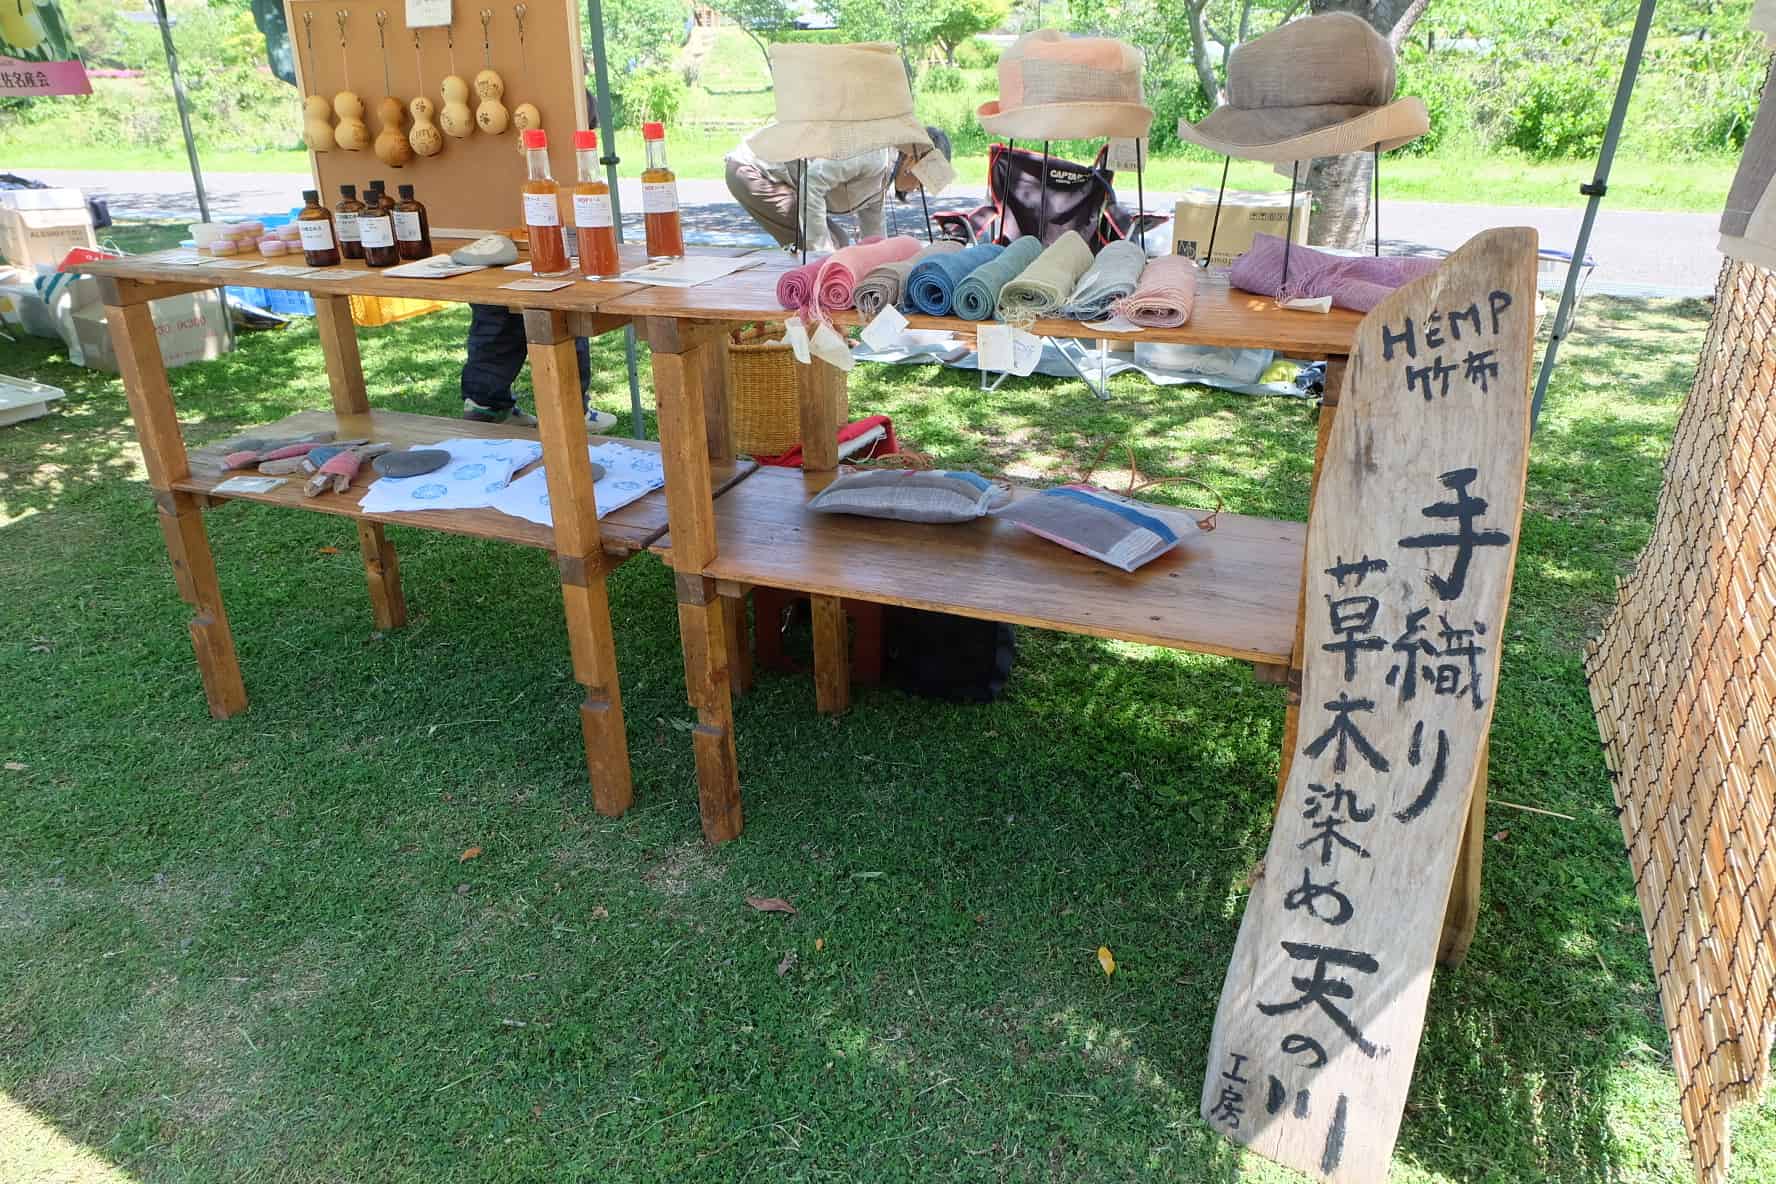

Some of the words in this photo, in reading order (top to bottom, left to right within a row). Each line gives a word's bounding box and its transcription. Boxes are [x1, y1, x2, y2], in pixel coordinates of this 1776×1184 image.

[1382, 290, 1512, 361] HEMP
[1406, 349, 1498, 401] 竹布
[1385, 467, 1511, 823] 手織り
[1211, 1053, 1248, 1129] 工房
